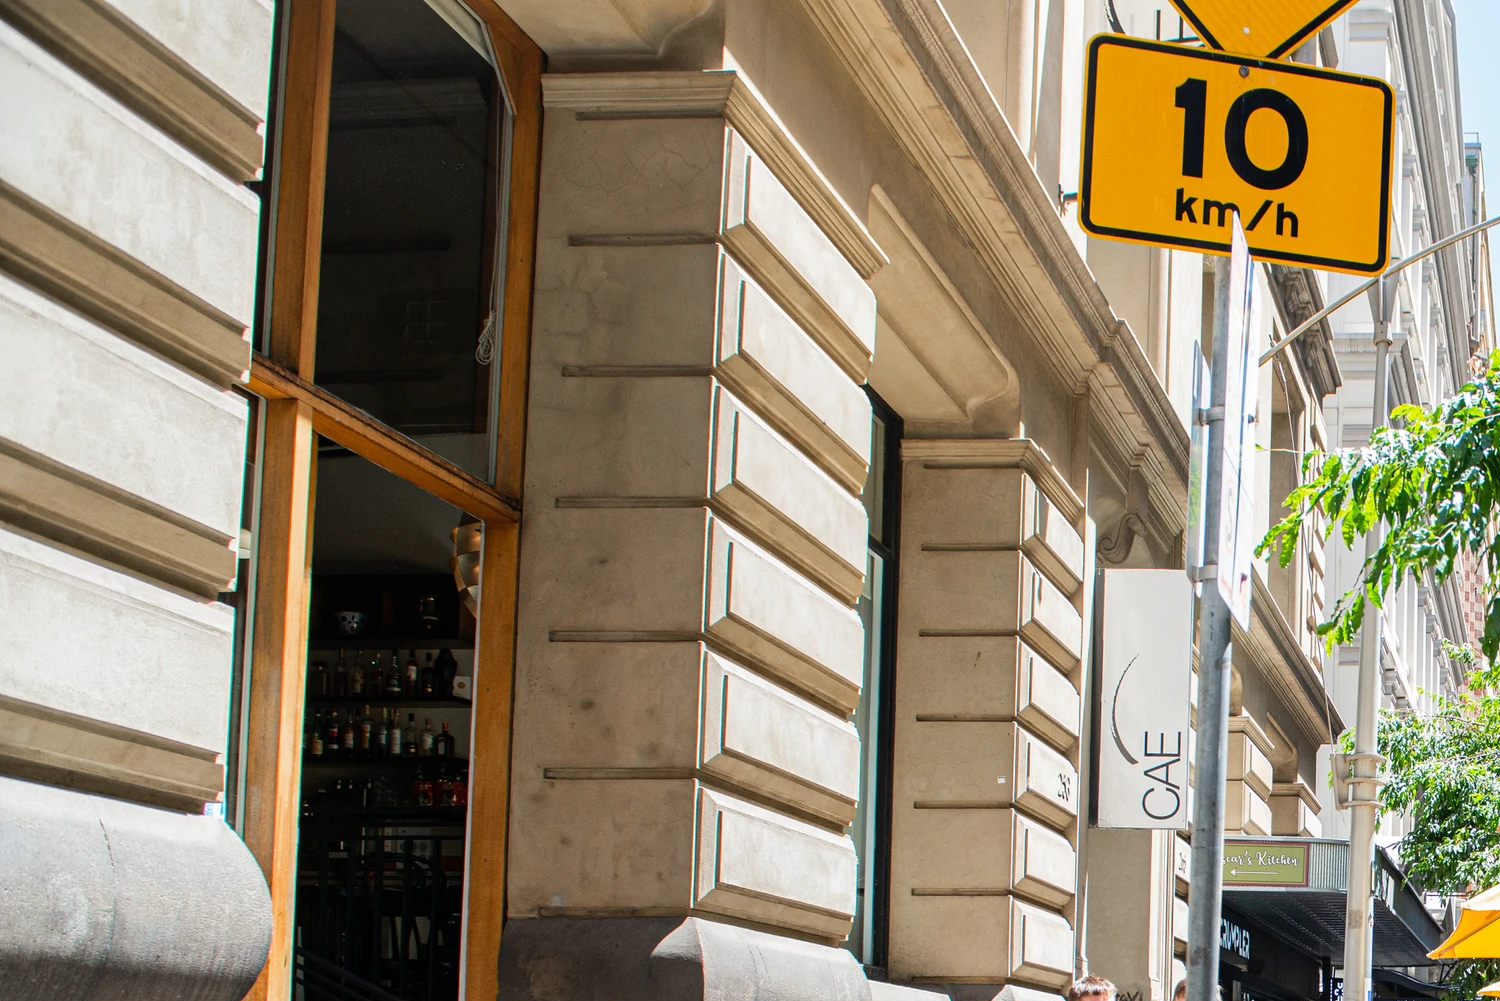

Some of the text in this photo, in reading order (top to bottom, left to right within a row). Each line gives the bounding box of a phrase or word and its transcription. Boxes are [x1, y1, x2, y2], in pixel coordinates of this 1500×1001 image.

[1174, 77, 1309, 191] 10
[1175, 187, 1299, 238] km/h
[1142, 730, 1181, 821] CAE
[1256, 851, 1299, 867] Kitchen
